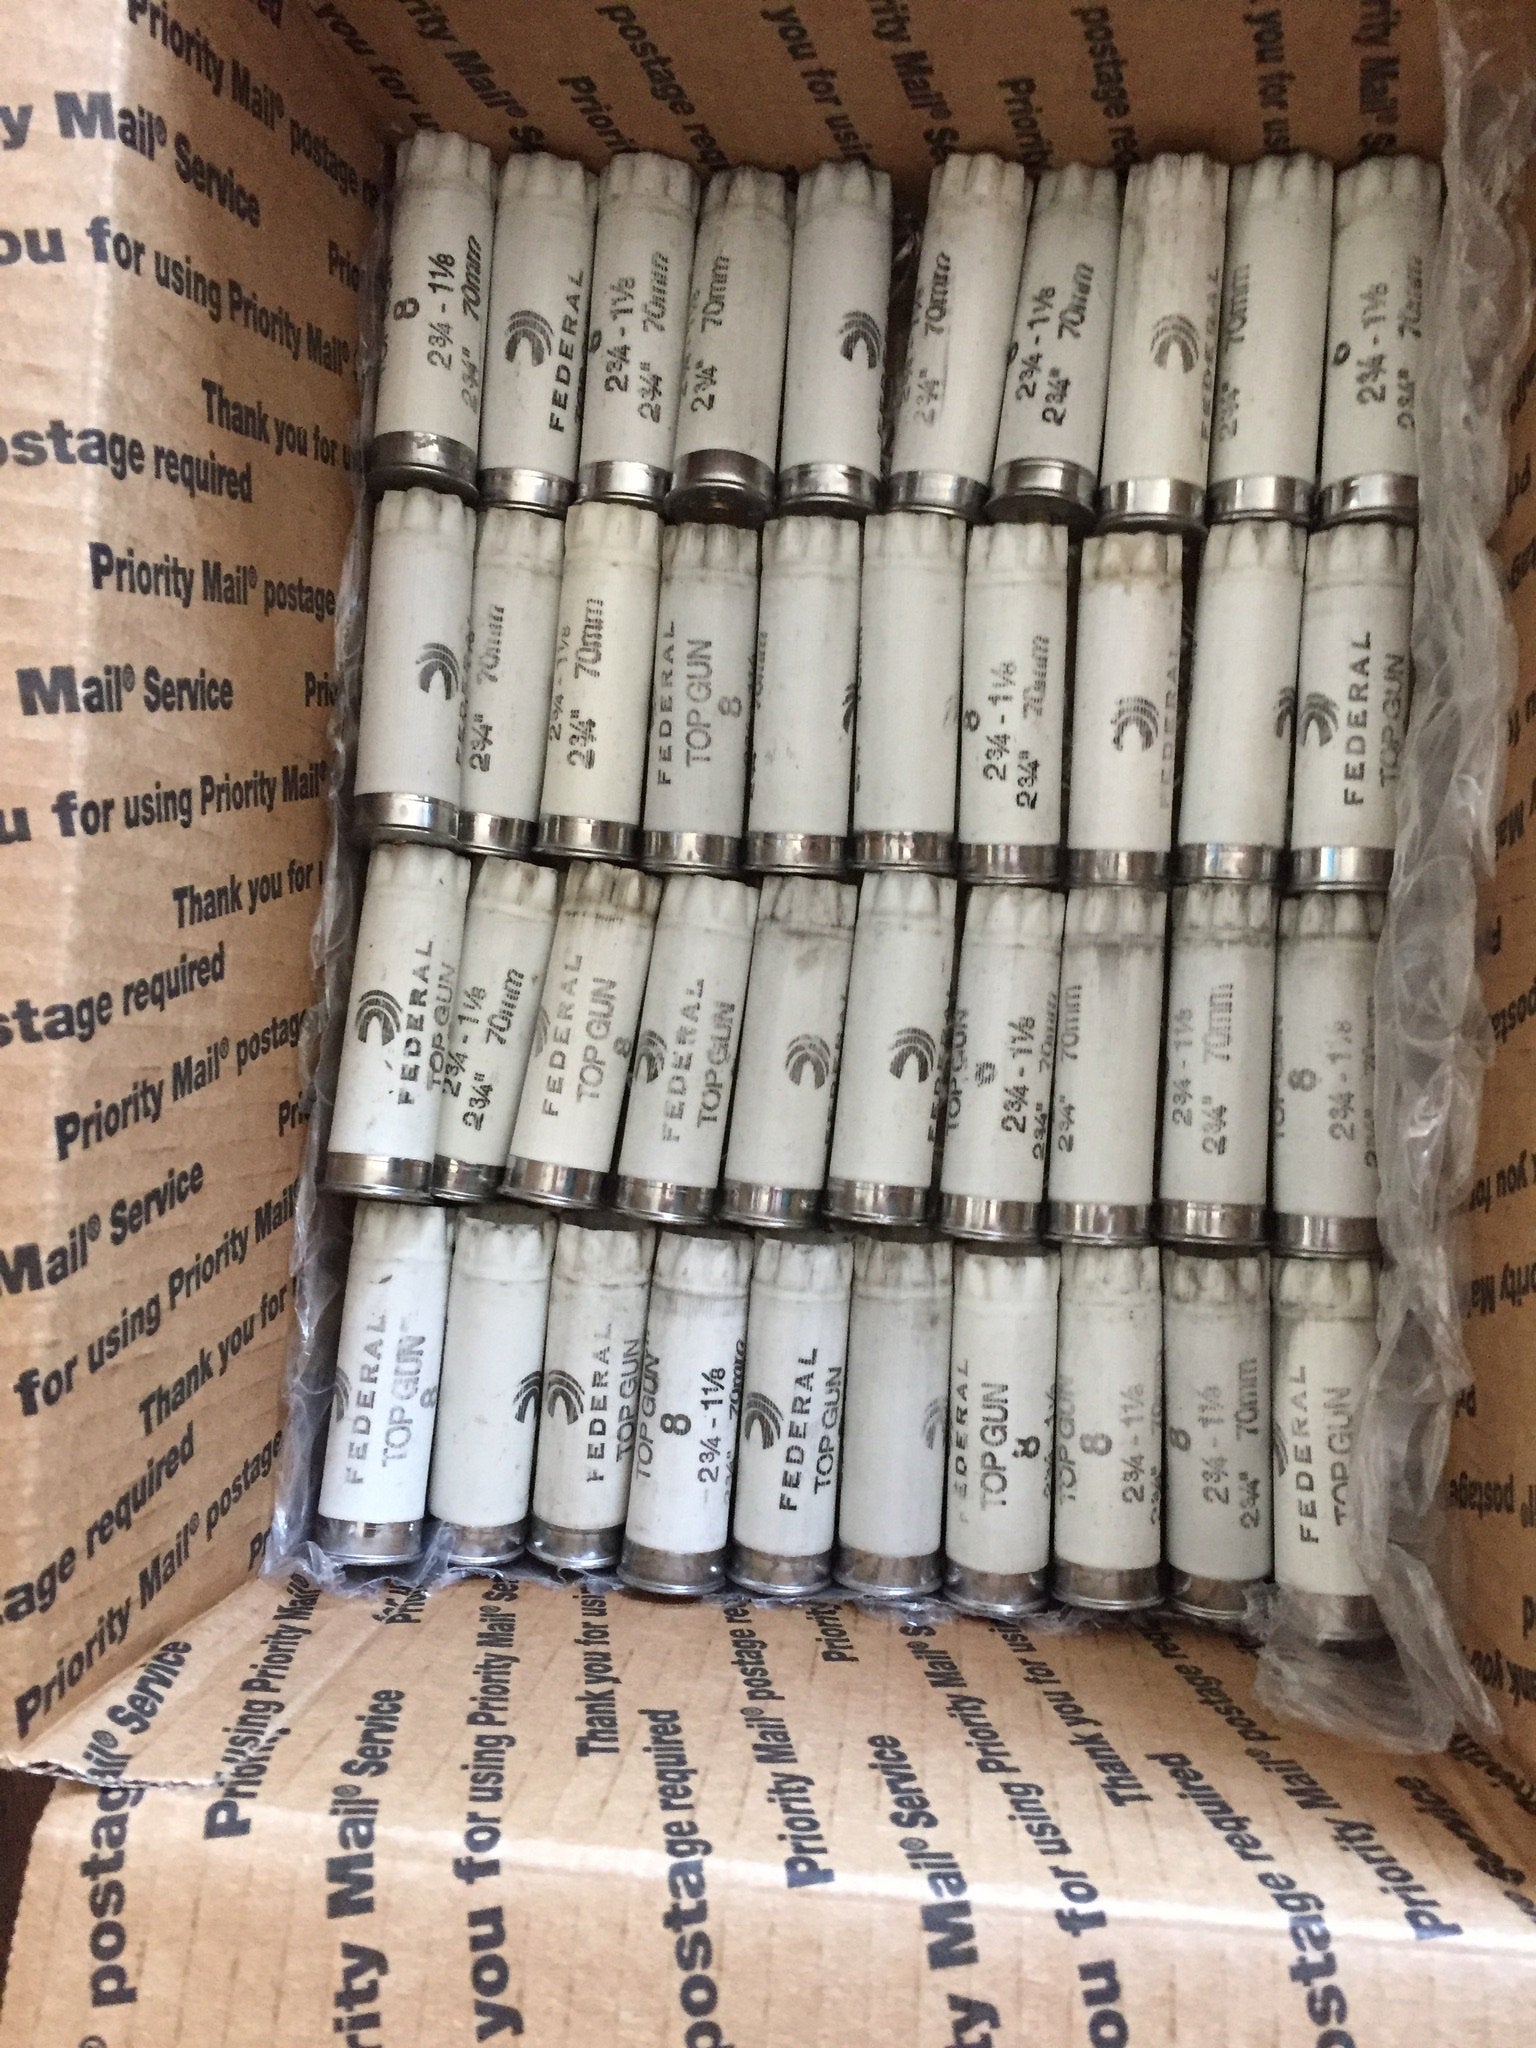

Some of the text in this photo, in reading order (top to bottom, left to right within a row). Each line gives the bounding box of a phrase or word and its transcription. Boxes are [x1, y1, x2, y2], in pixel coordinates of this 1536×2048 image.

[127, 0, 224, 97] Priority
[290, 119, 358, 196] postage
[596, 4, 696, 116] postage
[761, 6, 842, 107] you for
[174, 132, 260, 228] Service
[86, 216, 145, 276] for
[154, 250, 222, 323] using
[228, 279, 302, 361] Priority
[393, 297, 419, 321] 8
[549, 270, 583, 433] FEDERAL
[201, 378, 270, 445] Thank
[274, 416, 307, 456] you
[313, 425, 340, 466] for
[153, 443, 253, 502] required
[88, 541, 194, 608] Priority
[264, 577, 336, 622] postage
[573, 598, 604, 679] 70mm
[143, 665, 233, 712] Service
[657, 621, 674, 786] FEDERAL
[685, 639, 713, 768] TOP GUN
[717, 696, 742, 718] 8
[1343, 631, 1371, 806] FEDERAL
[51, 790, 115, 837] for
[123, 781, 192, 829] using
[200, 773, 277, 815] Priority
[172, 859, 313, 929] Thank you for
[123, 941, 225, 1016] required
[397, 940, 434, 1106] FEDERAL
[541, 955, 583, 1117] FEDERAL
[575, 977, 617, 1103] TOP GUN
[661, 978, 705, 1143] FEDERAL
[1286, 1068, 1317, 1093] 8
[54, 1080, 164, 1161] Priority
[236, 1009, 306, 1076] postag
[696, 1069, 723, 1129] TOP
[110, 1162, 204, 1246] Service
[13, 1356, 78, 1417] for
[88, 1293, 161, 1374] using
[168, 1226, 249, 1310] Priority
[139, 1284, 288, 1437] Thank you for
[344, 1315, 387, 1486] FEDERAL
[381, 1406, 414, 1468] TOP
[585, 1323, 612, 1483] FEDERAL
[659, 1412, 692, 1437] 8
[778, 1348, 819, 1512] FEDERAL
[979, 1382, 1009, 1447] GUN
[1078, 1432, 1114, 1458] 8
[85, 1420, 195, 1560] required
[813, 1435, 836, 1496] TOP
[1288, 1365, 1320, 1545] FEDERAL
[15, 1597, 131, 1739] Priority
[206, 1430, 283, 1542] postage
[107, 1641, 192, 1735] Service
[241, 1624, 312, 1693] Priority
[467, 1653, 520, 1726] Priority
[574, 1622, 622, 1757] Thank you for
[729, 1629, 785, 1700] postage
[1175, 1664, 1281, 1743] postage
[341, 1689, 405, 1777] Service
[461, 1734, 516, 1802] using
[638, 1708, 698, 1811] required
[946, 1694, 1021, 1774] Priority
[1018, 1658, 1153, 1807] Thank you for
[867, 1735, 938, 1828] Service
[1000, 1782, 1073, 1855] using
[1145, 1752, 1275, 1862] required
[454, 1811, 502, 1885] for
[767, 1771, 834, 1888] Priority
[80, 1785, 145, 2009] postag
[1049, 1865, 1107, 1936] for
[1325, 1817, 1463, 1941] Priority
[468, 1905, 525, 2044] you
